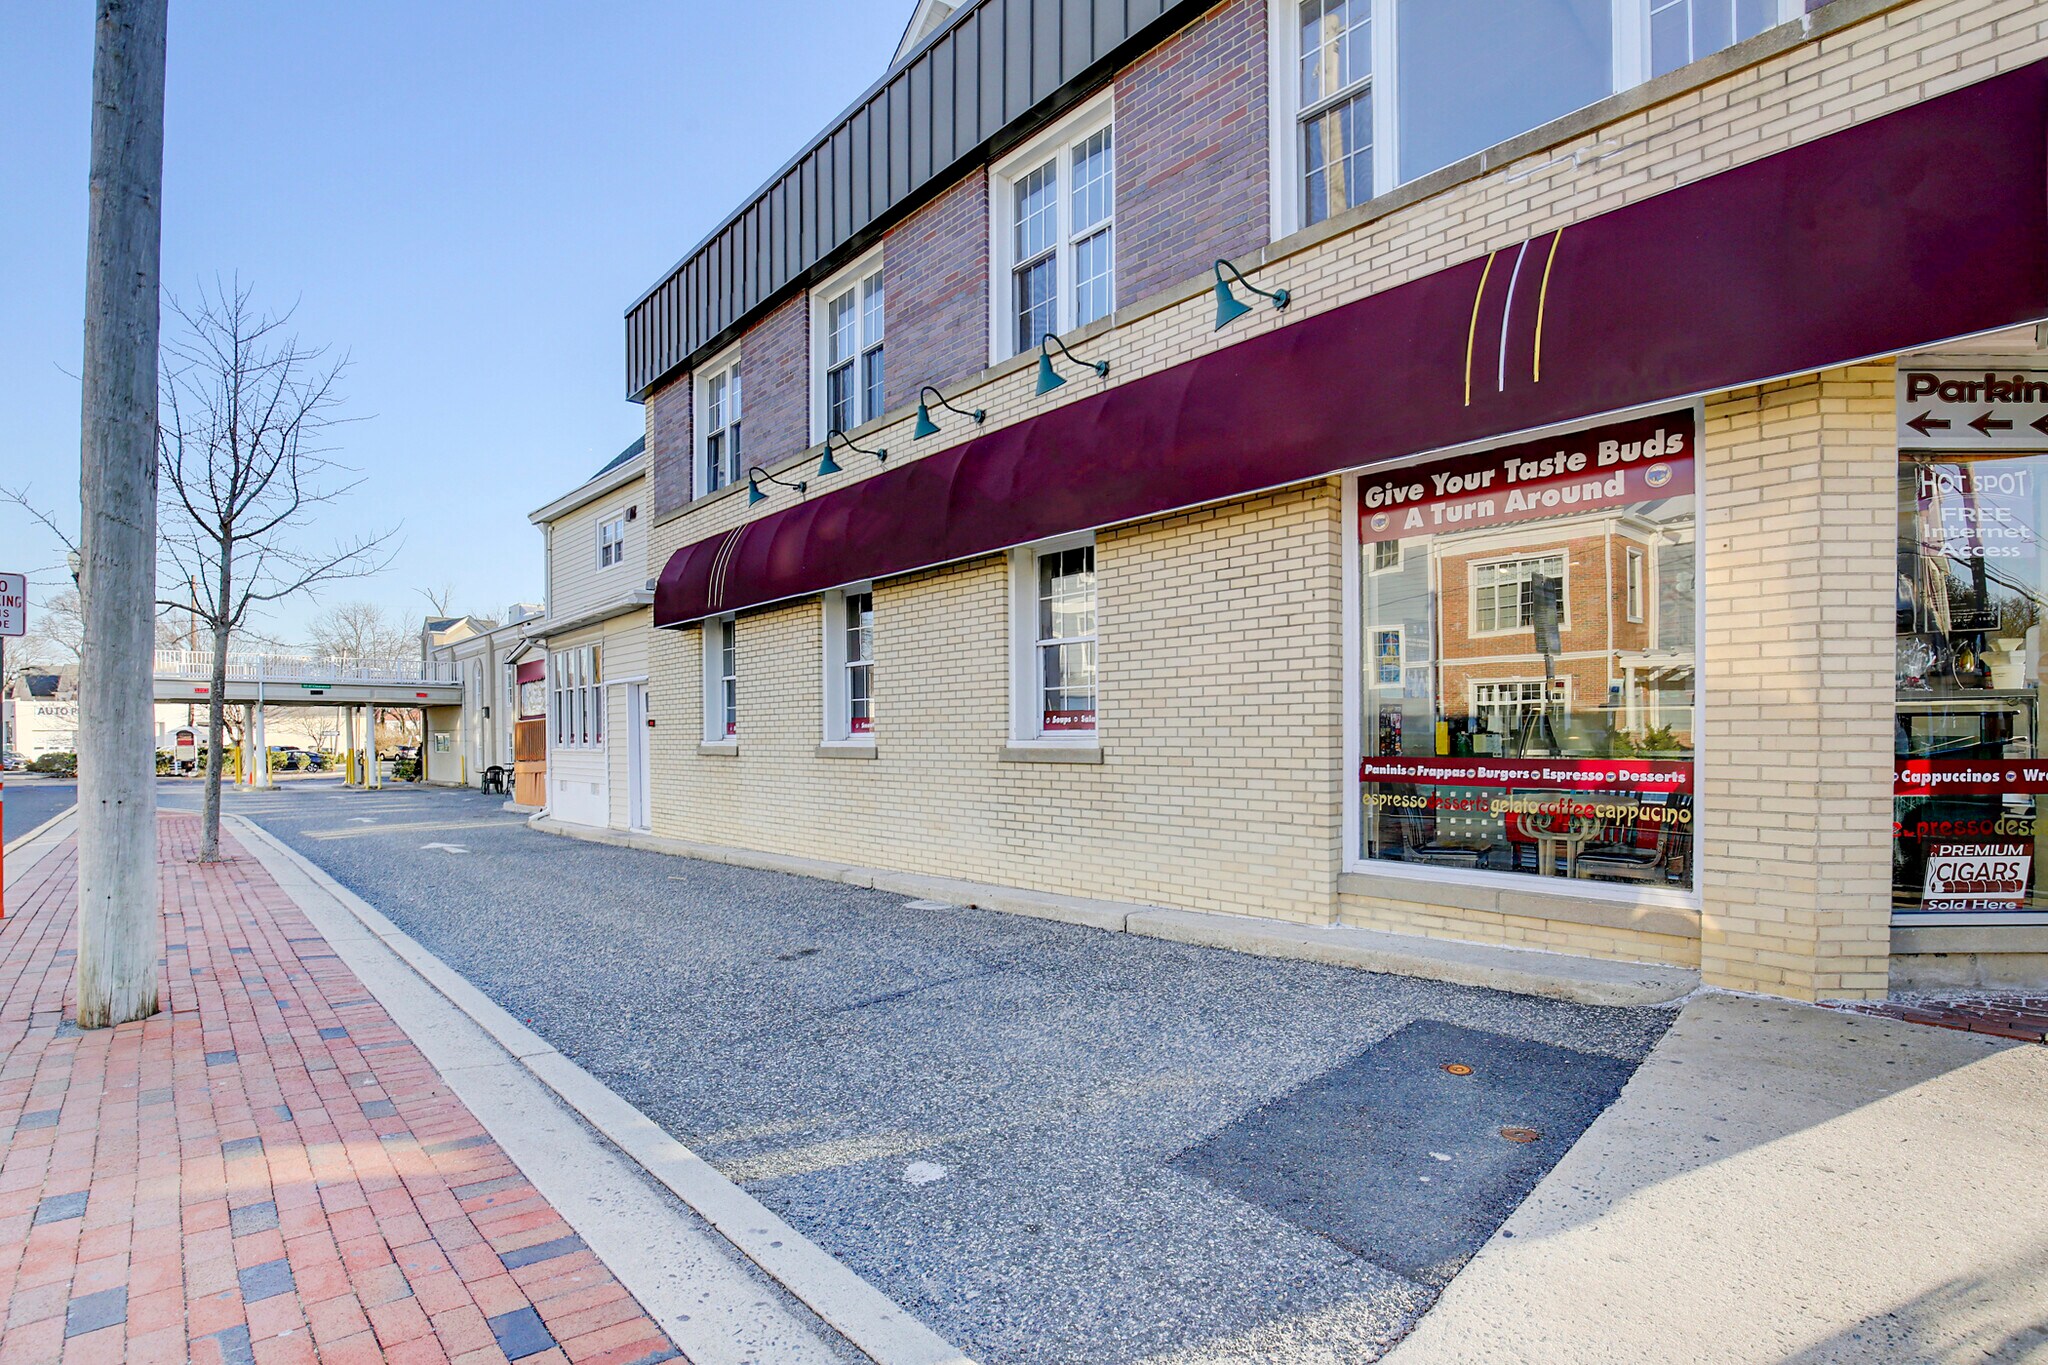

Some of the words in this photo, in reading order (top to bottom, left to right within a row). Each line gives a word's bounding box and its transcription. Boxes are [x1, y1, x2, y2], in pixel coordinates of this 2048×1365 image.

[1906, 372, 2048, 403] Parkin
[1365, 482, 1425, 509] Give
[1431, 468, 1496, 497] Your
[1504, 450, 1588, 484] Taste
[1597, 428, 1685, 467] Buds
[1921, 468, 1967, 498] HOT
[1973, 470, 2027, 497] SPOT
[1403, 506, 1425, 530] A
[1430, 499, 1495, 525] Turn
[1504, 469, 1625, 514] Around
[1941, 507, 2012, 522] FREE
[1924, 523, 2031, 538] Internet
[1937, 542, 2021, 557] Access
[0, 595, 22, 608] ING
[37, 706, 69, 716] AUTO
[1364, 764, 1407, 776] Paninis
[1417, 765, 1466, 780] Frappas
[1477, 767, 1530, 782] Burgers
[1542, 768, 1604, 783] Espresso
[1618, 769, 1687, 784] Desserts
[1901, 768, 2000, 787] Cappuccinos
[2023, 768, 2048, 782] Wr
[1362, 792, 1428, 811] espresso
[1427, 791, 1489, 812] desserts
[1489, 793, 1539, 819] gelato
[1538, 798, 1596, 819] coffee
[1939, 844, 2024, 856] PREMIUM
[1936, 862, 2020, 881] CIGARS
[1927, 900, 1967, 911] Sold
[1972, 900, 2017, 910] Here
